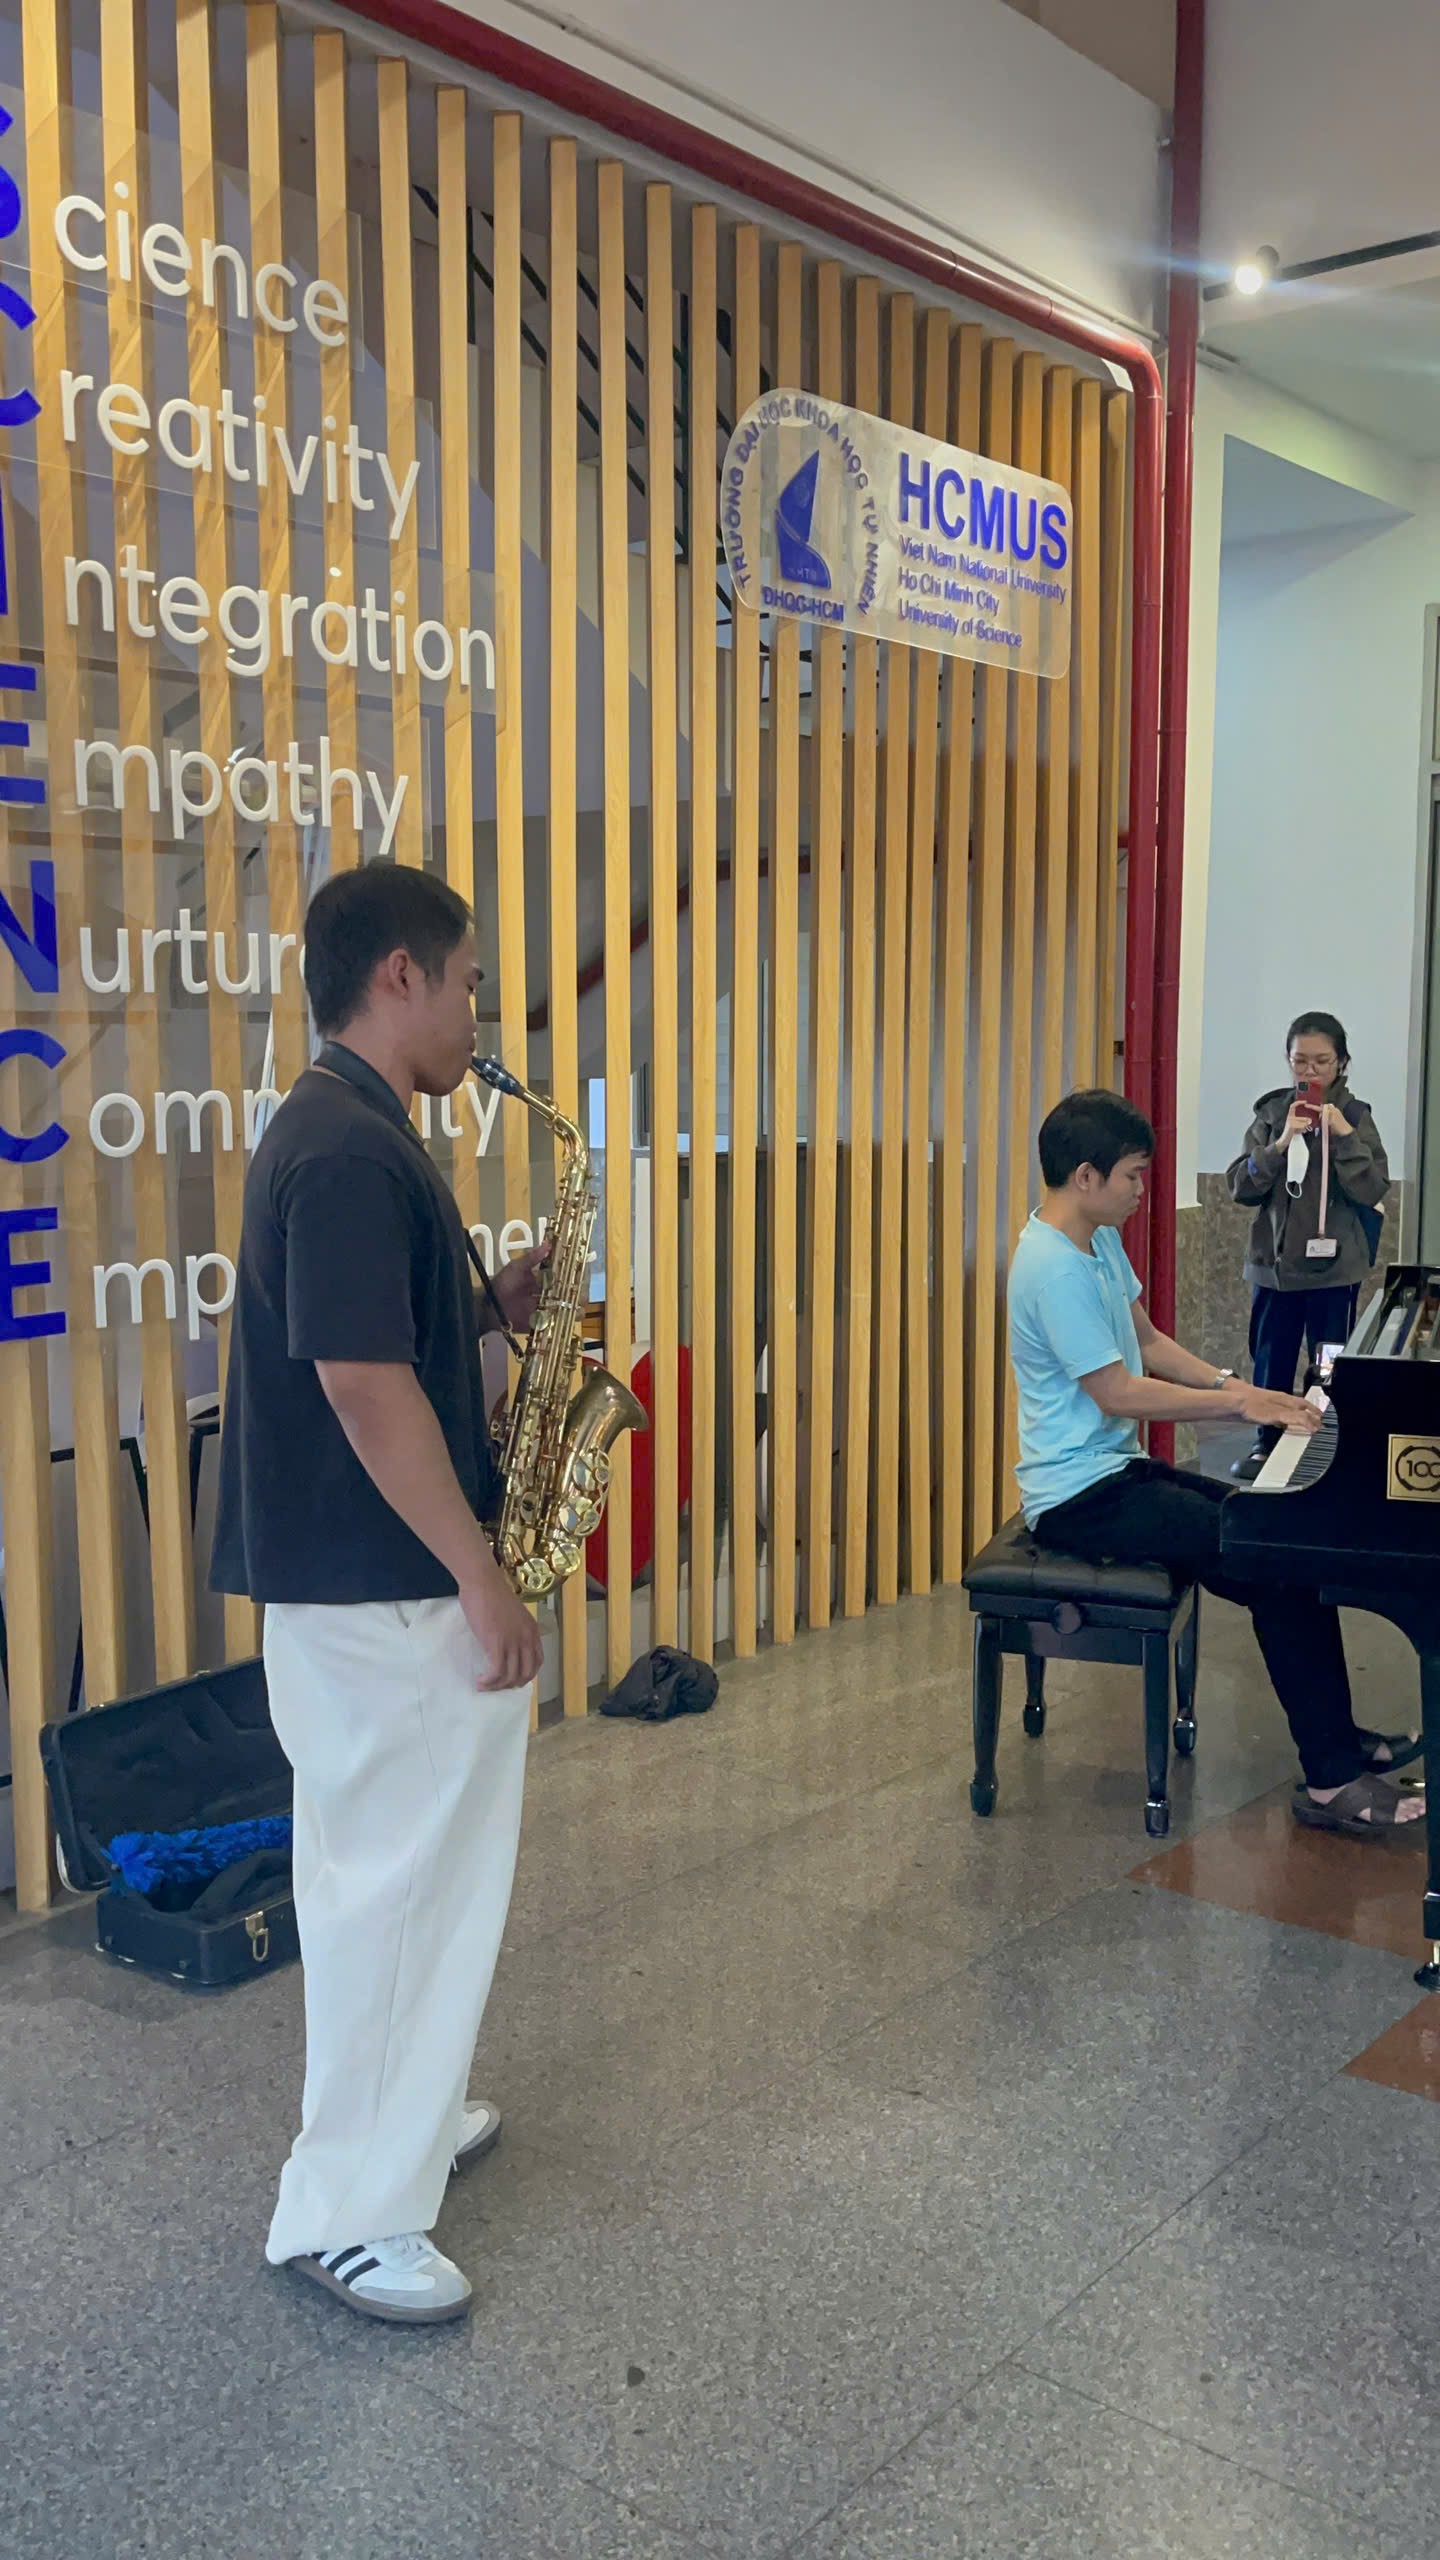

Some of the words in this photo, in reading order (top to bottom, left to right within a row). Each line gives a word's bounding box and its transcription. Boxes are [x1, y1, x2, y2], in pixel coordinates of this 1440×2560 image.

[54, 182, 348, 347] cience
[60, 369, 421, 540] reativity
[795, 398, 839, 442] KHOA
[900, 452, 1067, 570] HCMUS
[64, 545, 495, 690] ntegration
[899, 535, 924, 561] Viet
[928, 544, 956, 570] Nam
[960, 554, 1008, 585] National
[1011, 569, 1067, 604] University
[899, 566, 917, 591] Ho
[920, 573, 941, 597] Chi
[944, 580, 973, 605] Minh
[977, 590, 999, 616] City
[899, 599, 959, 636] University
[962, 617, 973, 635] of
[976, 619, 1022, 648] Science
[74, 735, 409, 855] mpathy
[79, 908, 306, 995] urtur
